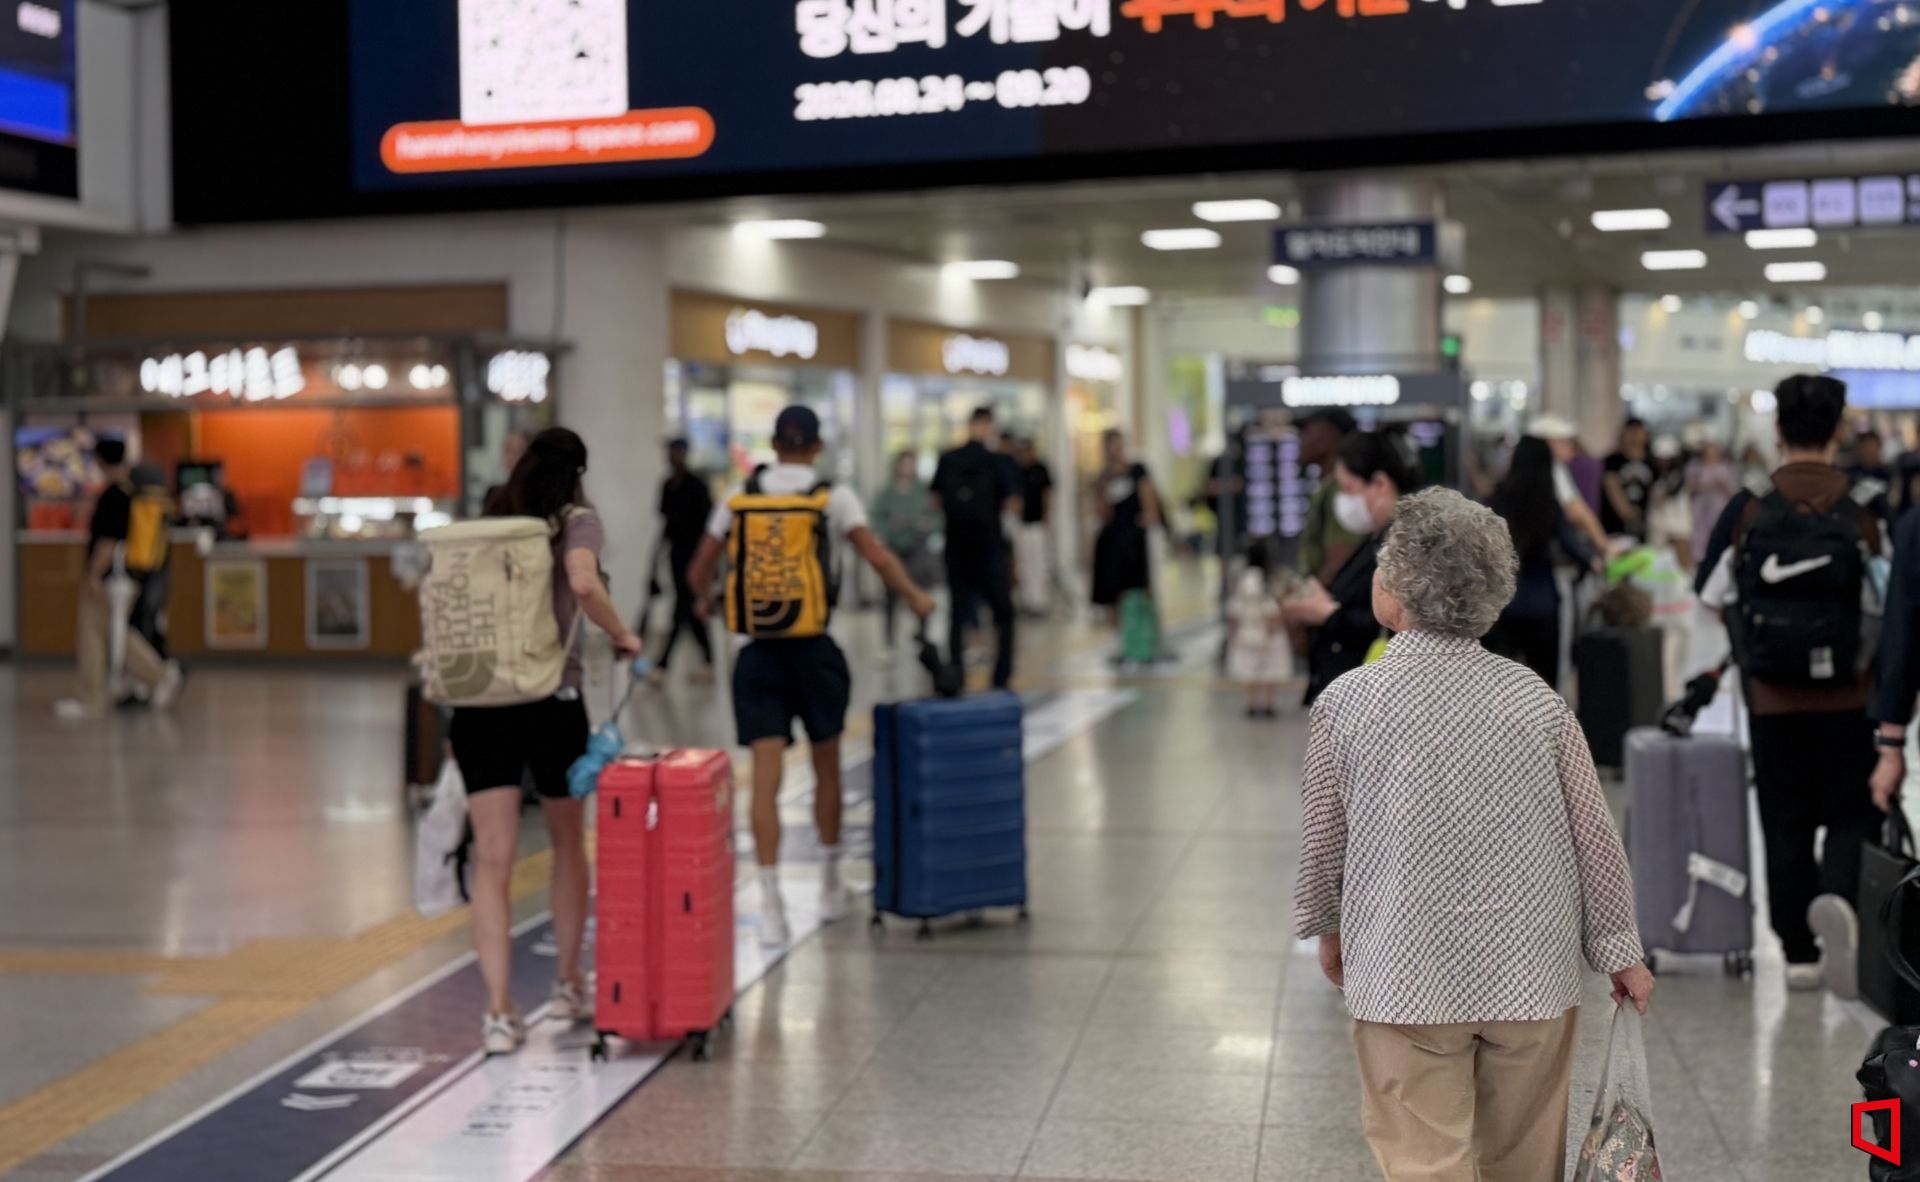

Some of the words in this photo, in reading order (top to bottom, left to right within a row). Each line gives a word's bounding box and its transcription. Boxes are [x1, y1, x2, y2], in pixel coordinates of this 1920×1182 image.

[795, 0, 946, 58] 당신의
[432, 582, 451, 648] FACE
[451, 551, 472, 649] NORTH
[472, 593, 496, 648] THE
